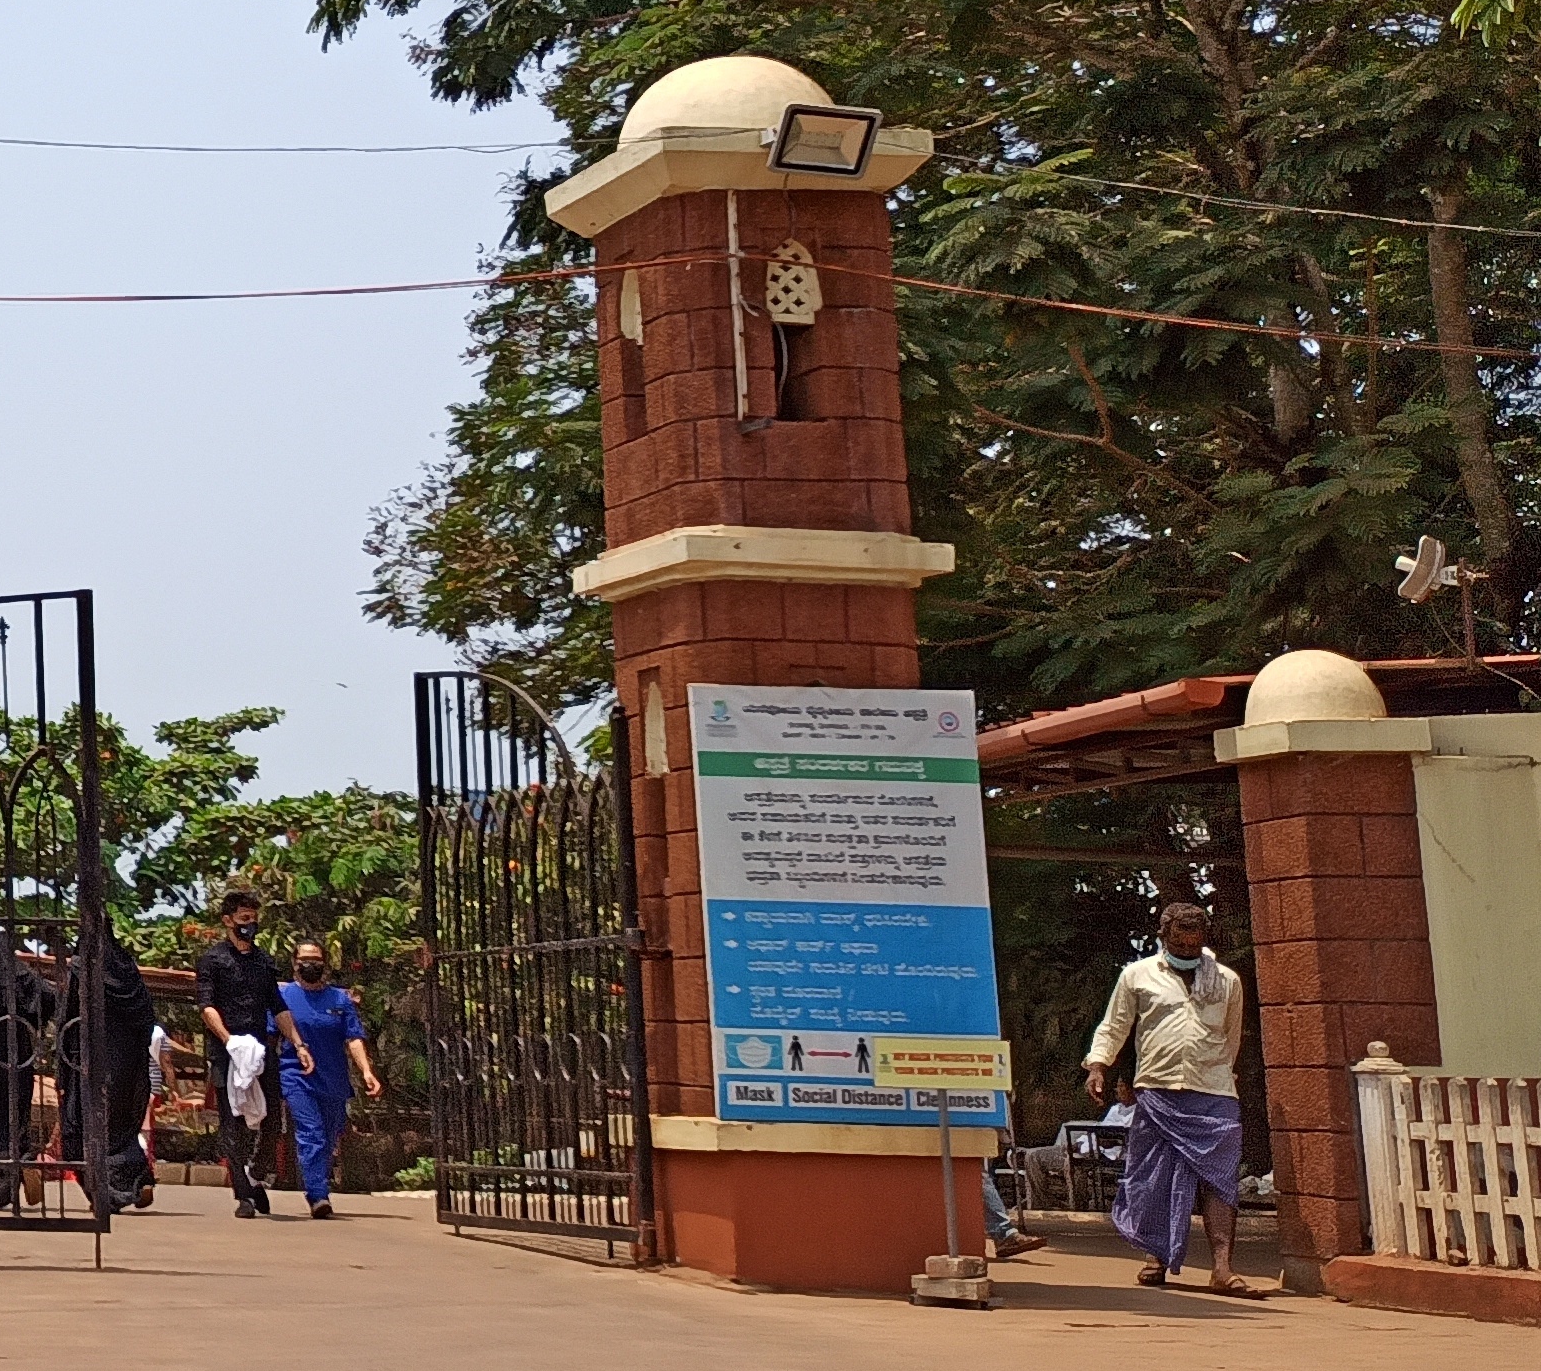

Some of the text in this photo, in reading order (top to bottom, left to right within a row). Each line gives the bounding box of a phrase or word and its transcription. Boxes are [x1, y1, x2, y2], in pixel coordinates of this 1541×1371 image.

[735, 1086, 991, 1109] Mask Social Distance Clenness
